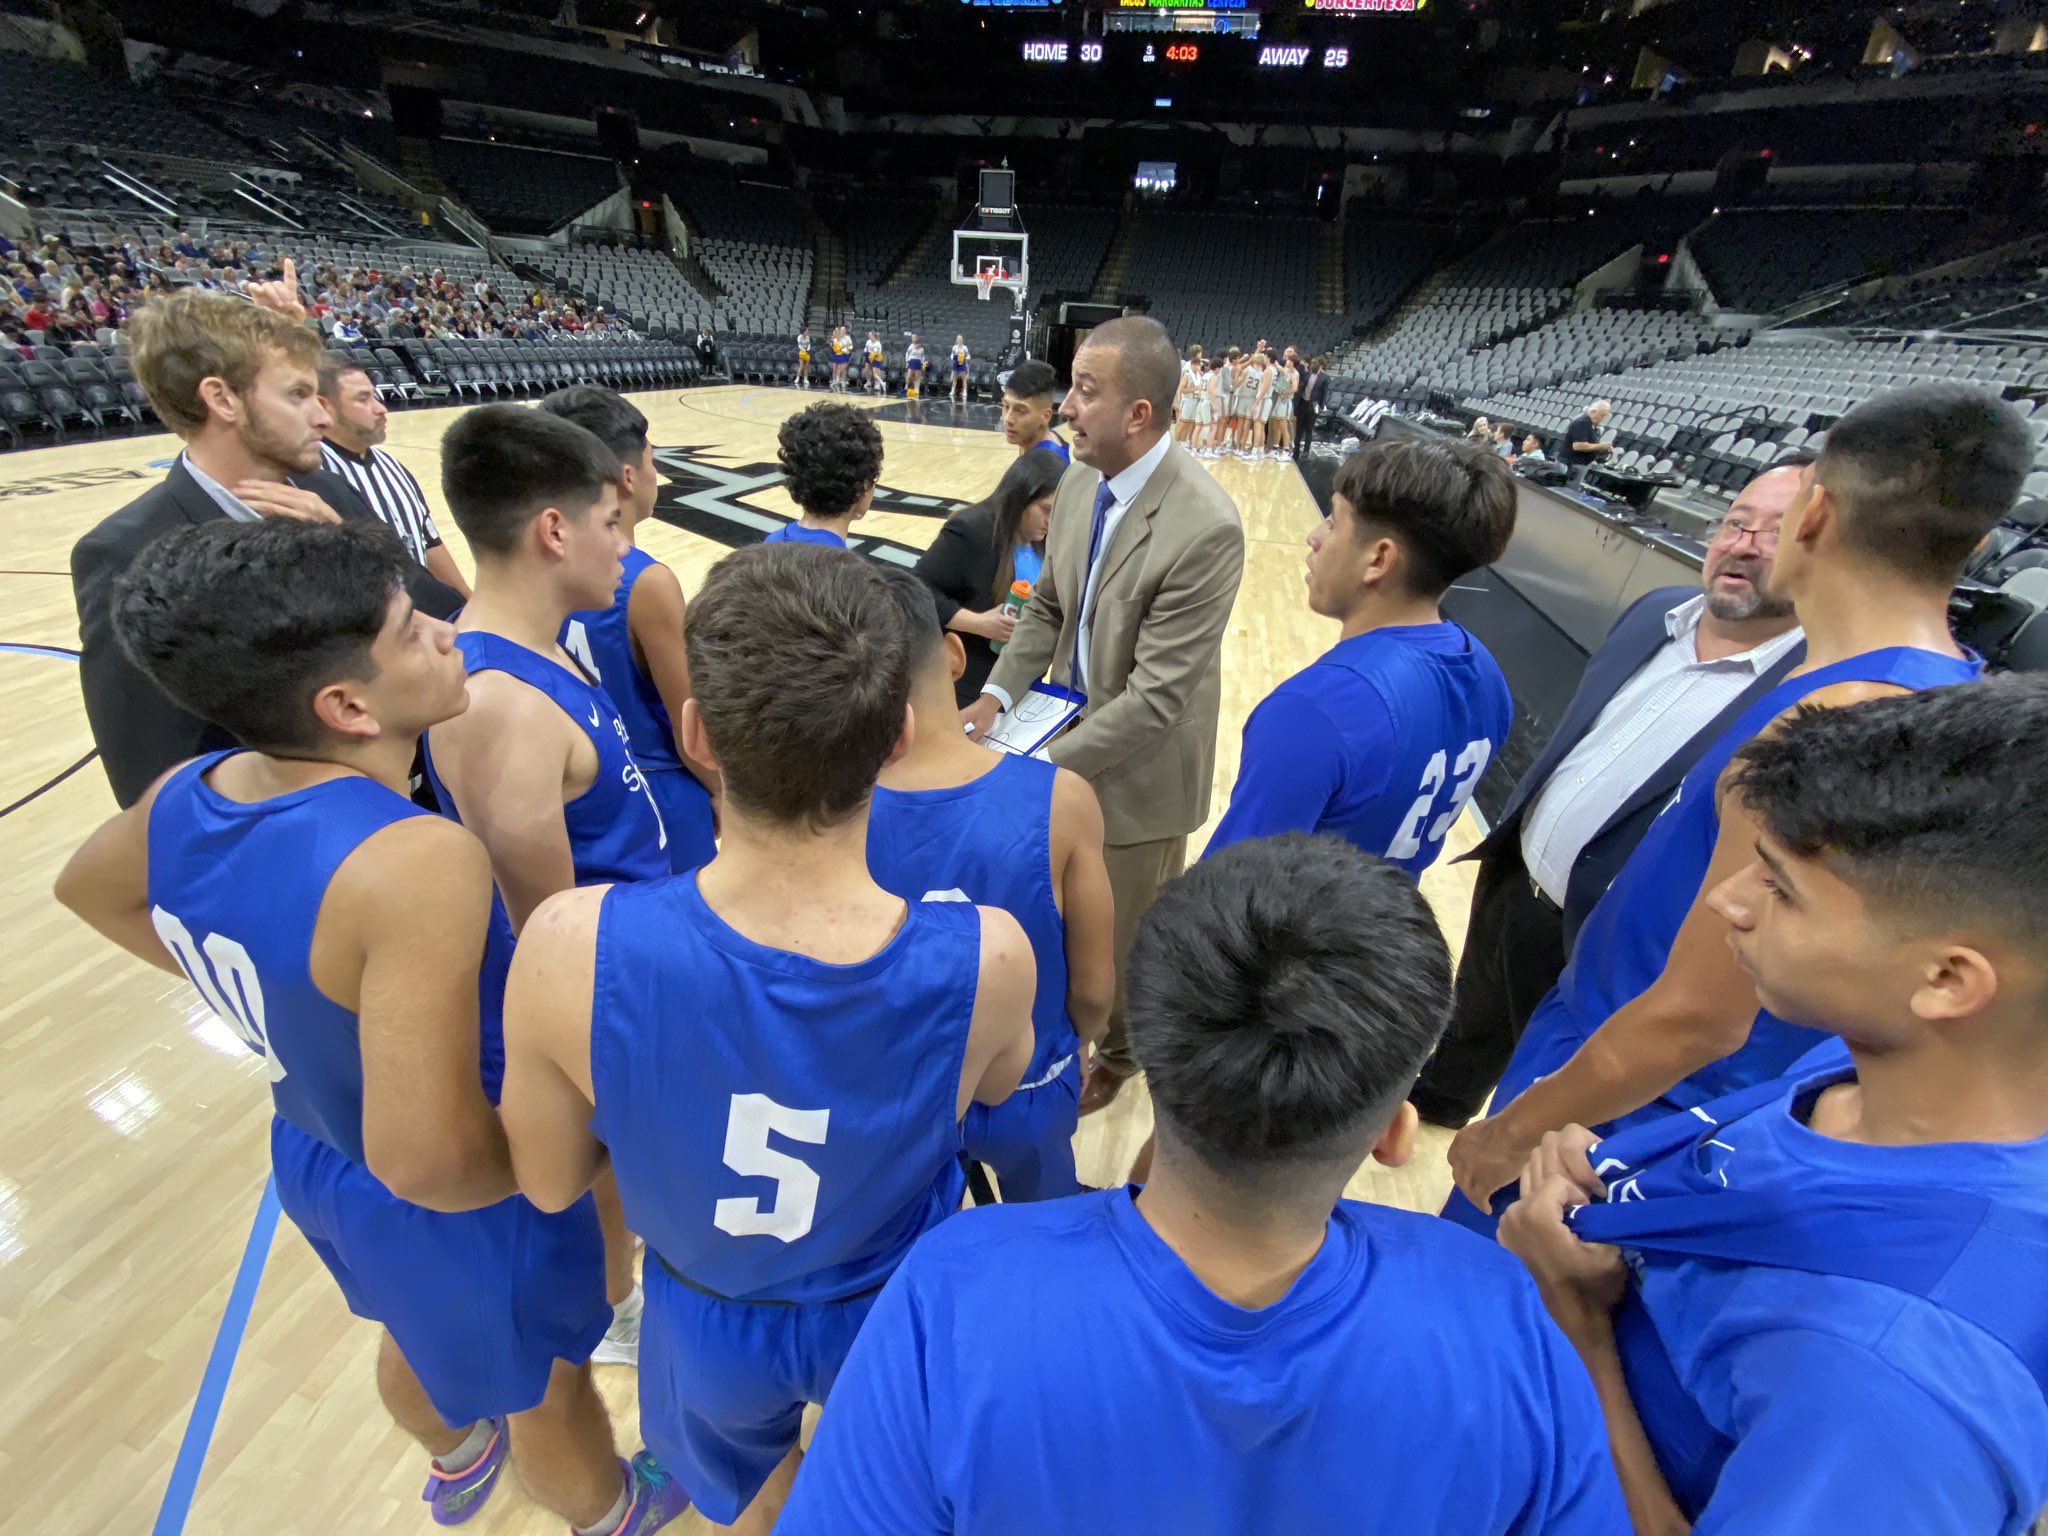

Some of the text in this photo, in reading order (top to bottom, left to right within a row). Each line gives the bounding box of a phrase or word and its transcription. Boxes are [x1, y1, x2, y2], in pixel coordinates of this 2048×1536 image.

[1023, 43, 1102, 62] HOME 30
[1146, 45, 1152, 55] 3
[1166, 46, 1198, 61] 4:03
[1259, 47, 1349, 67] AWAY 25
[1246, 376, 1260, 391] 23
[1383, 737, 1492, 859] 23
[713, 1093, 830, 1243] 5
